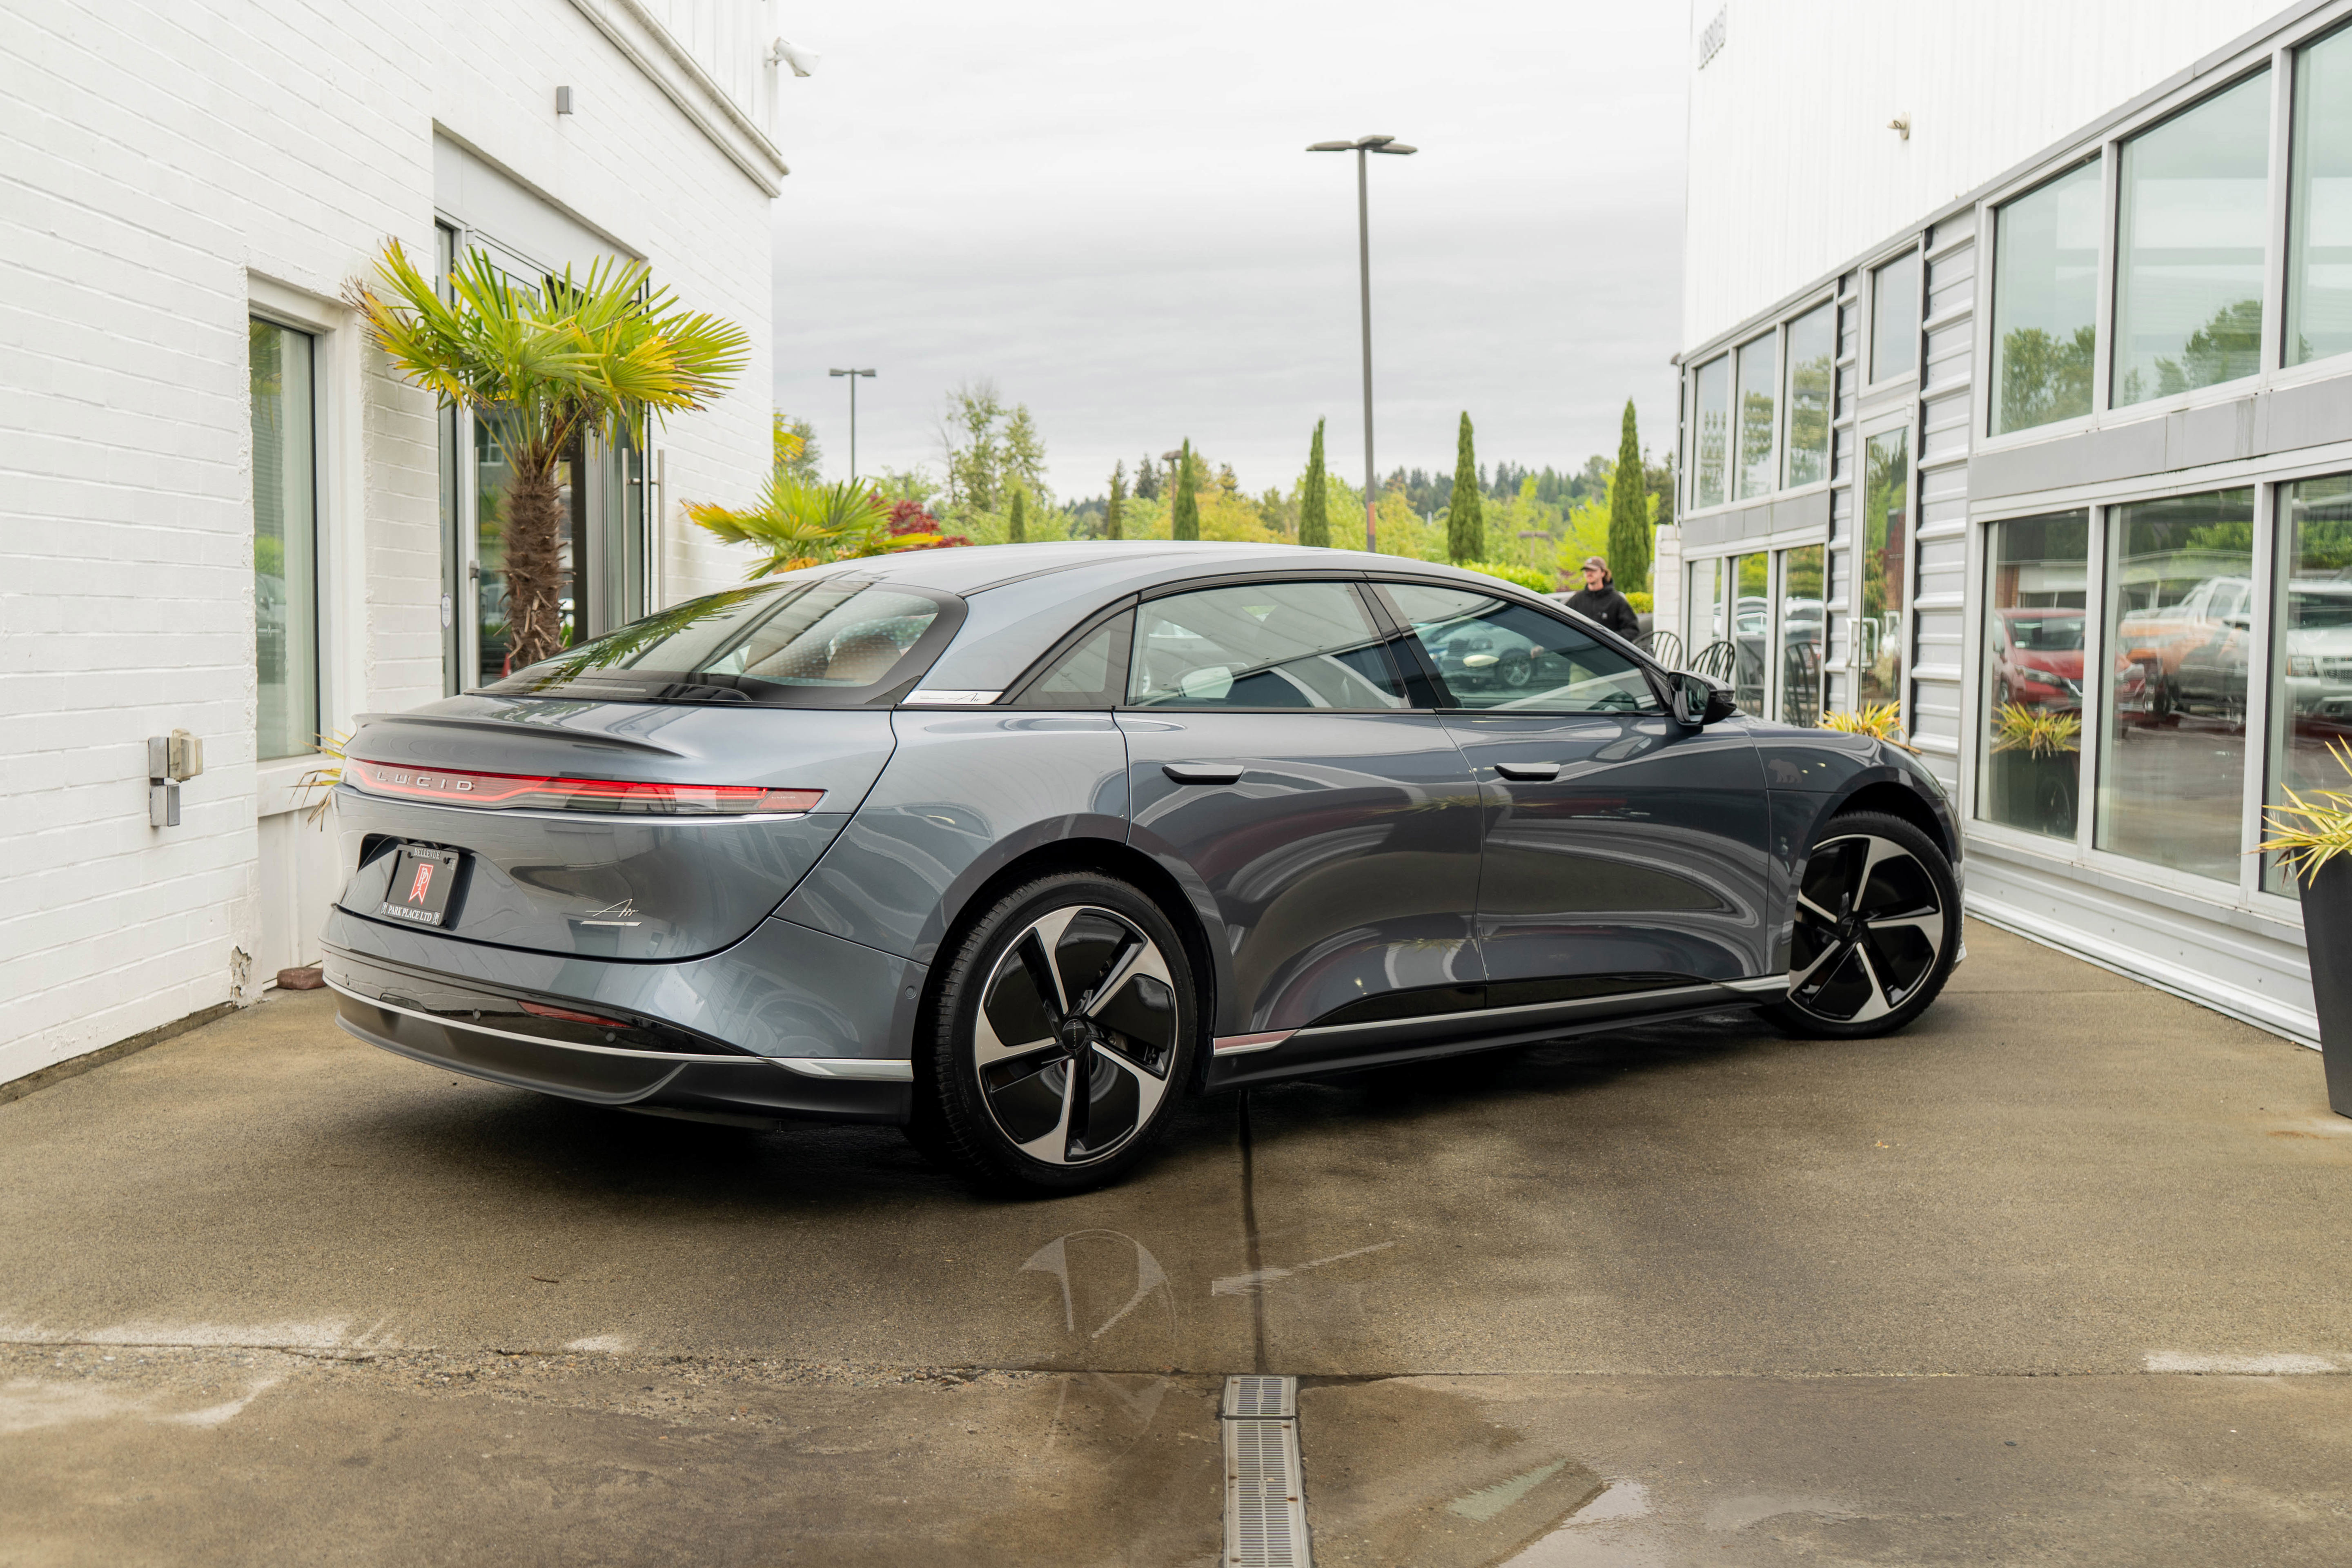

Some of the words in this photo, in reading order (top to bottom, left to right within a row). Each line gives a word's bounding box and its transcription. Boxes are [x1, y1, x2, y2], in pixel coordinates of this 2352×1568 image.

[948, 693, 981, 702] Air
[376, 771, 474, 791] LUCID
[414, 848, 441, 860] BELLEVUE
[388, 905, 403, 915] PARK
[401, 908, 420, 920] PLACE
[419, 911, 432, 922] LTD
[585, 898, 639, 918] Air
